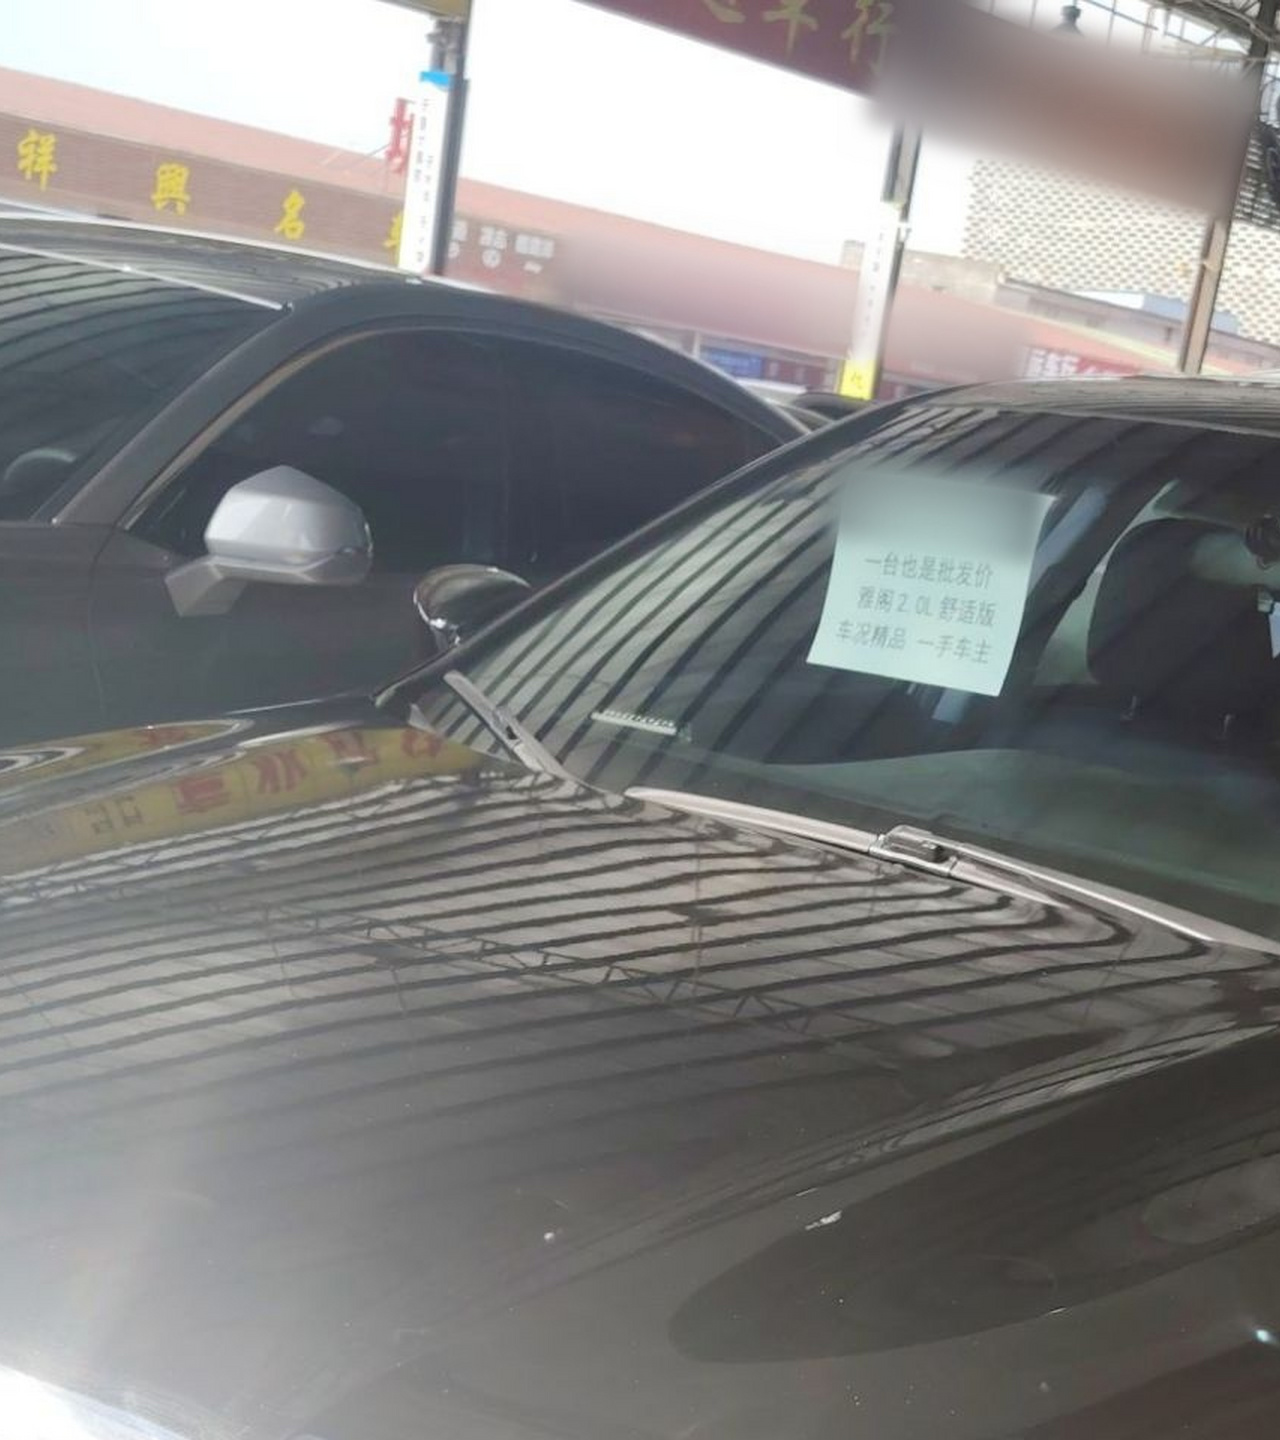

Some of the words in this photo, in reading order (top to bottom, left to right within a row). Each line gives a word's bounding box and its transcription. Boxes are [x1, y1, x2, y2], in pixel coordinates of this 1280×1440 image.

[865, 551, 994, 589] 一台也是批发价
[836, 618, 906, 650] 车况精品
[916, 634, 993, 664] 一手车主
